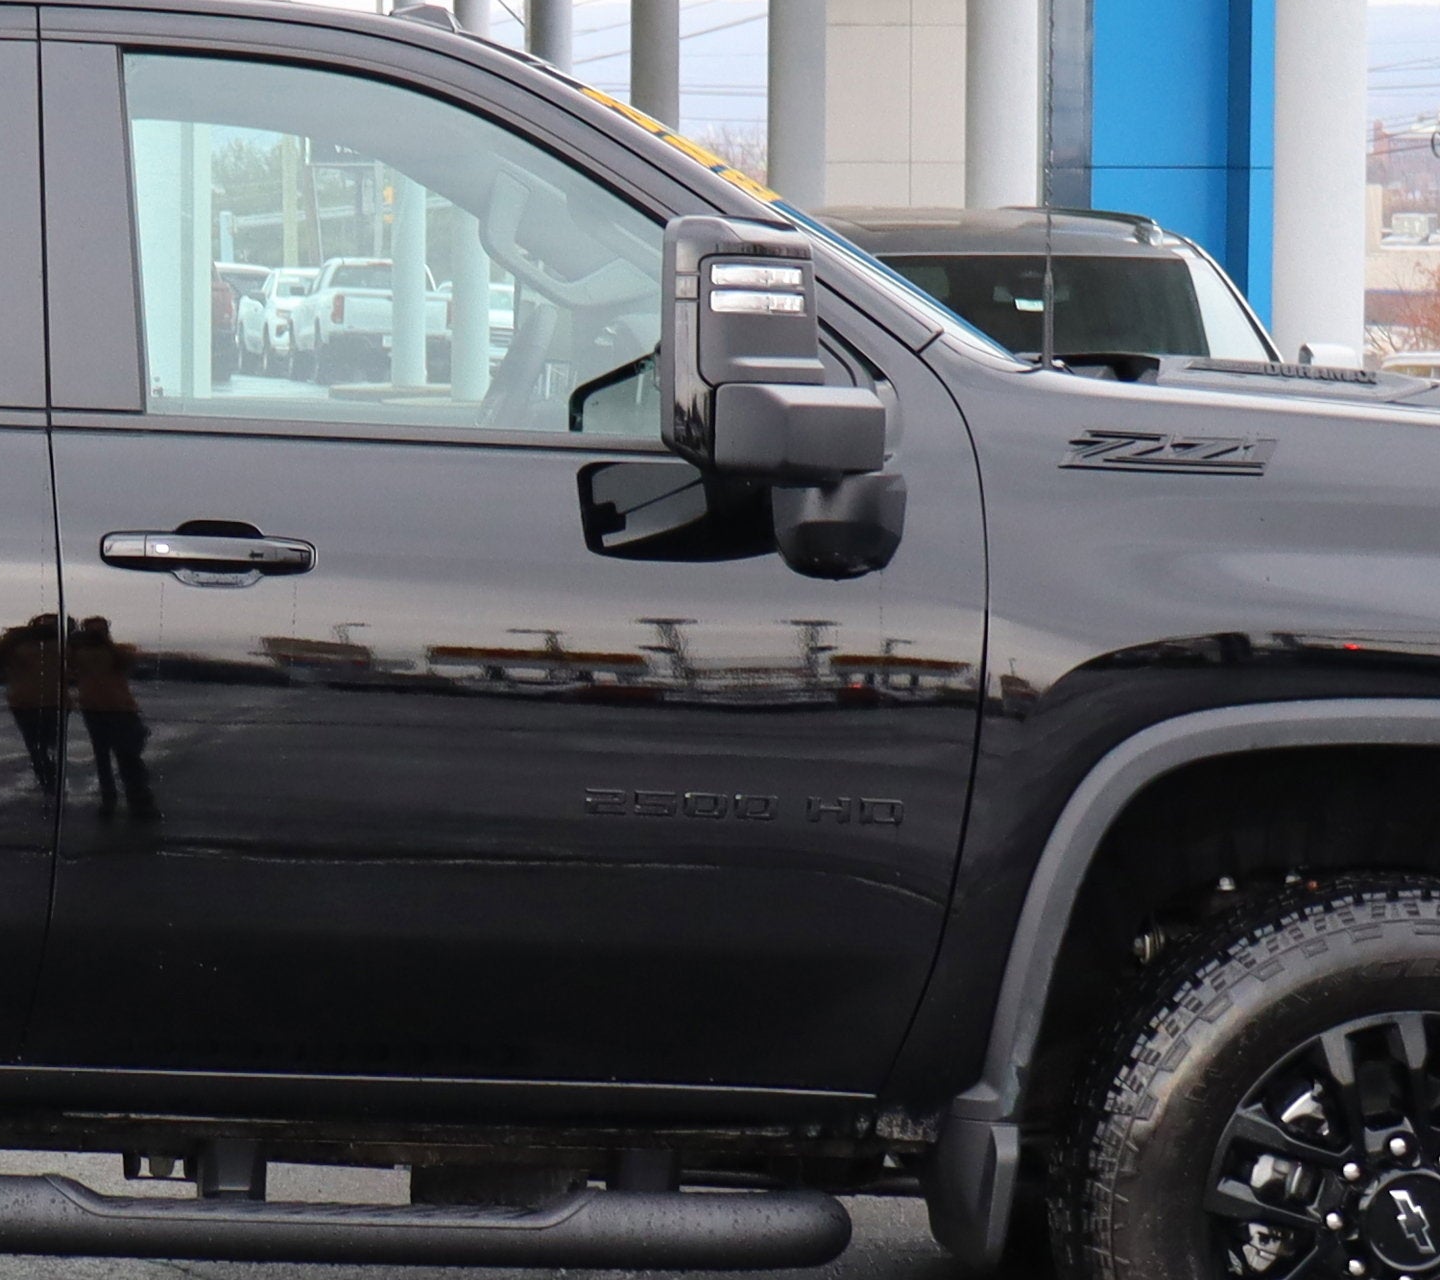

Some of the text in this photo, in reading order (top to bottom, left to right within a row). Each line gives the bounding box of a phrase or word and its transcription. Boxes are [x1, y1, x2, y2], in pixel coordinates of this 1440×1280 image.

[1058, 428, 1279, 477] Z71
[584, 787, 905, 826] 2500 HD
